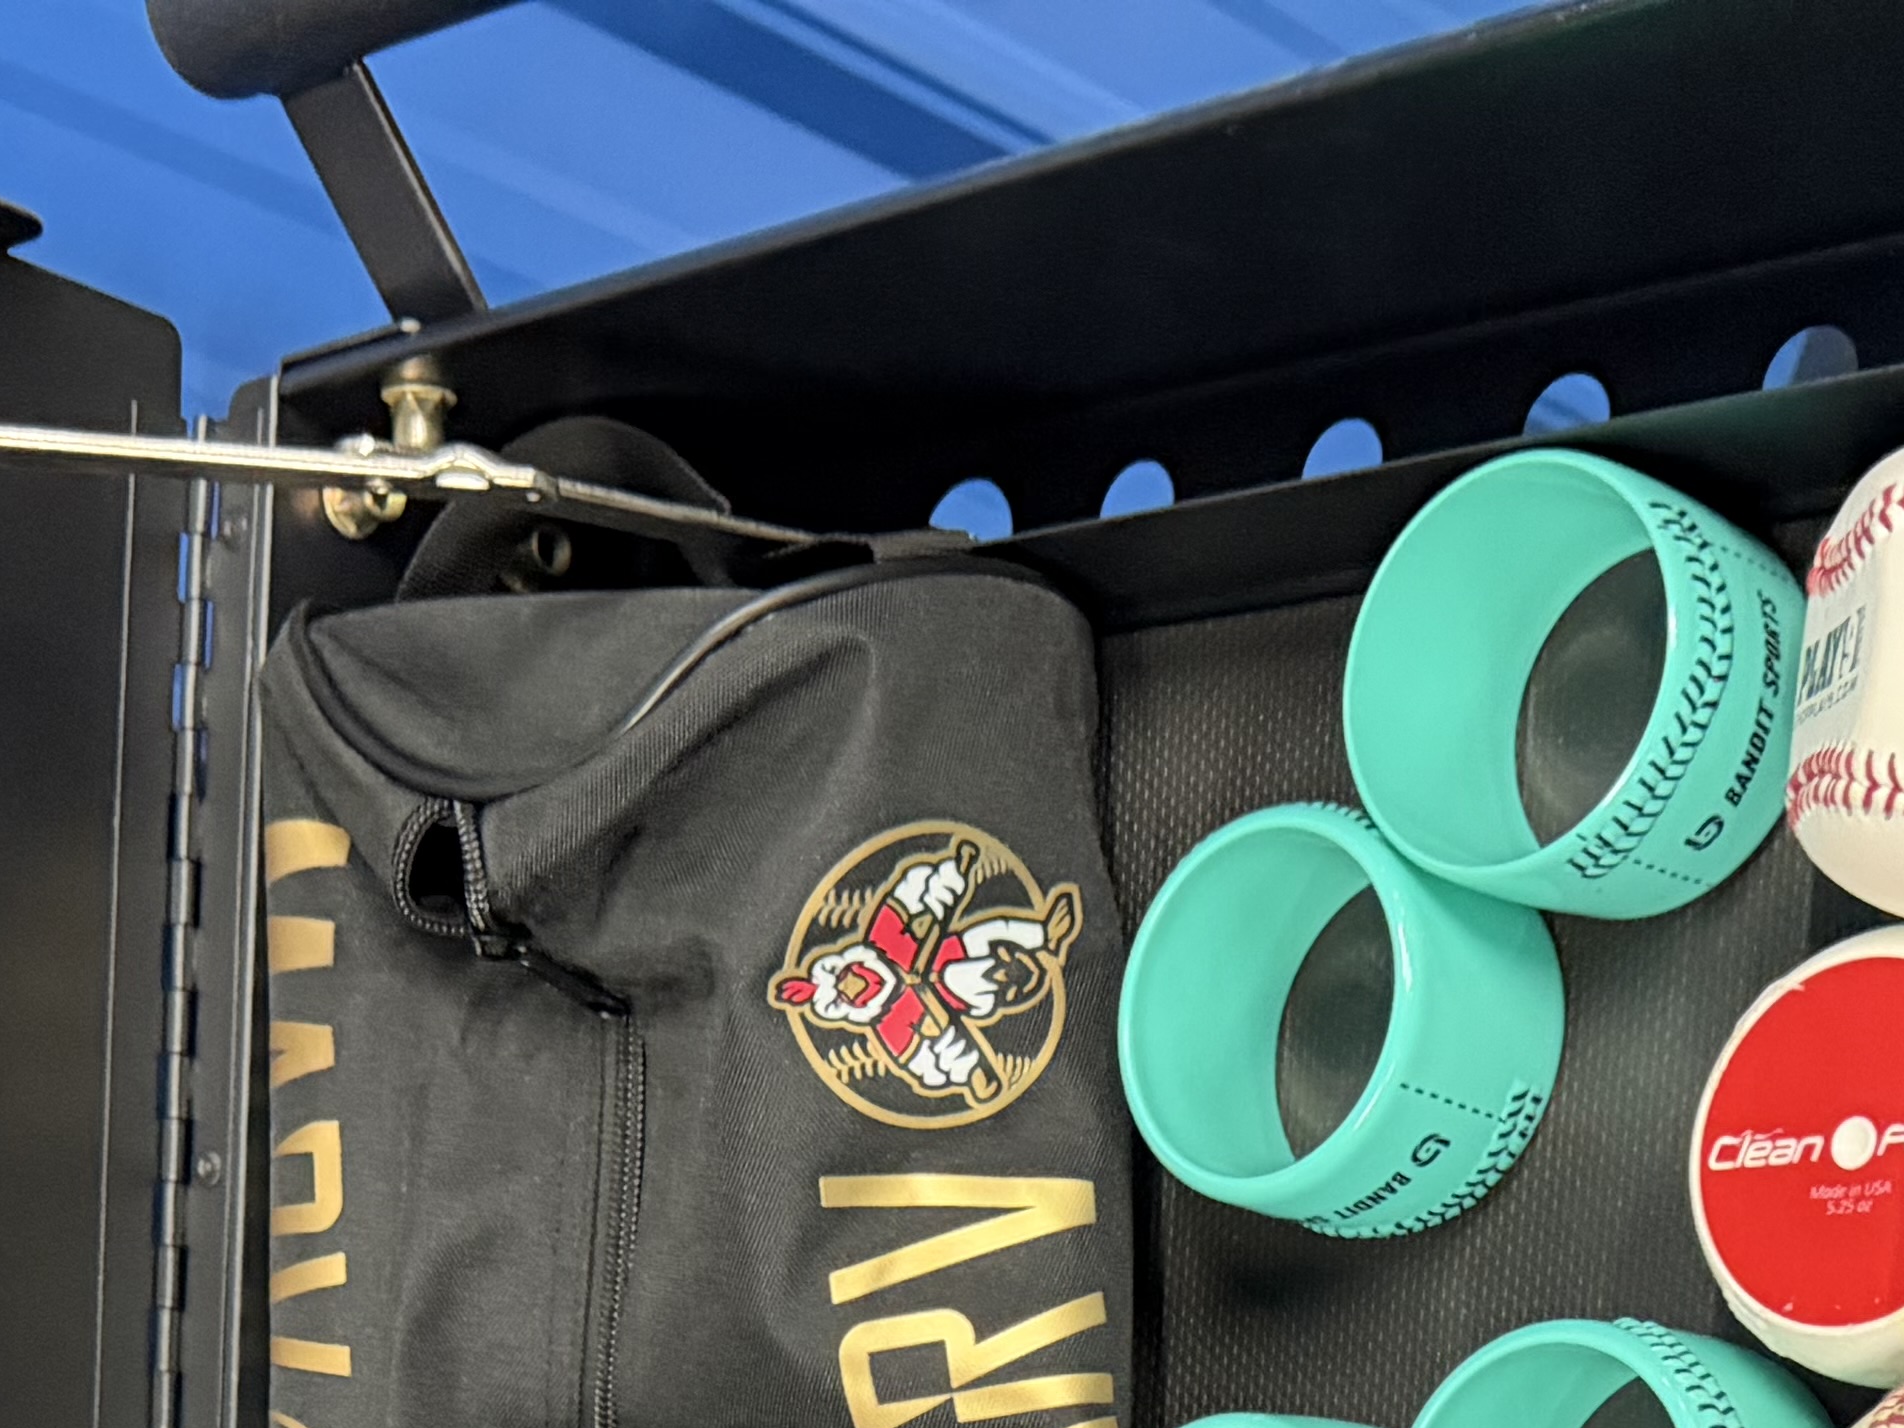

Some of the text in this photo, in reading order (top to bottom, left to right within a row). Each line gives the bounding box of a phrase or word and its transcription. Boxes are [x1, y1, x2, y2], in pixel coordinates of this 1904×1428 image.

[1724, 697, 1774, 807] BANDIT
[1757, 588, 1781, 698] SPORTS
[1708, 1129, 1825, 1171] Clean
[1333, 1172, 1412, 1219] BANDIT
[1809, 1180, 1893, 1200] Made in USA
